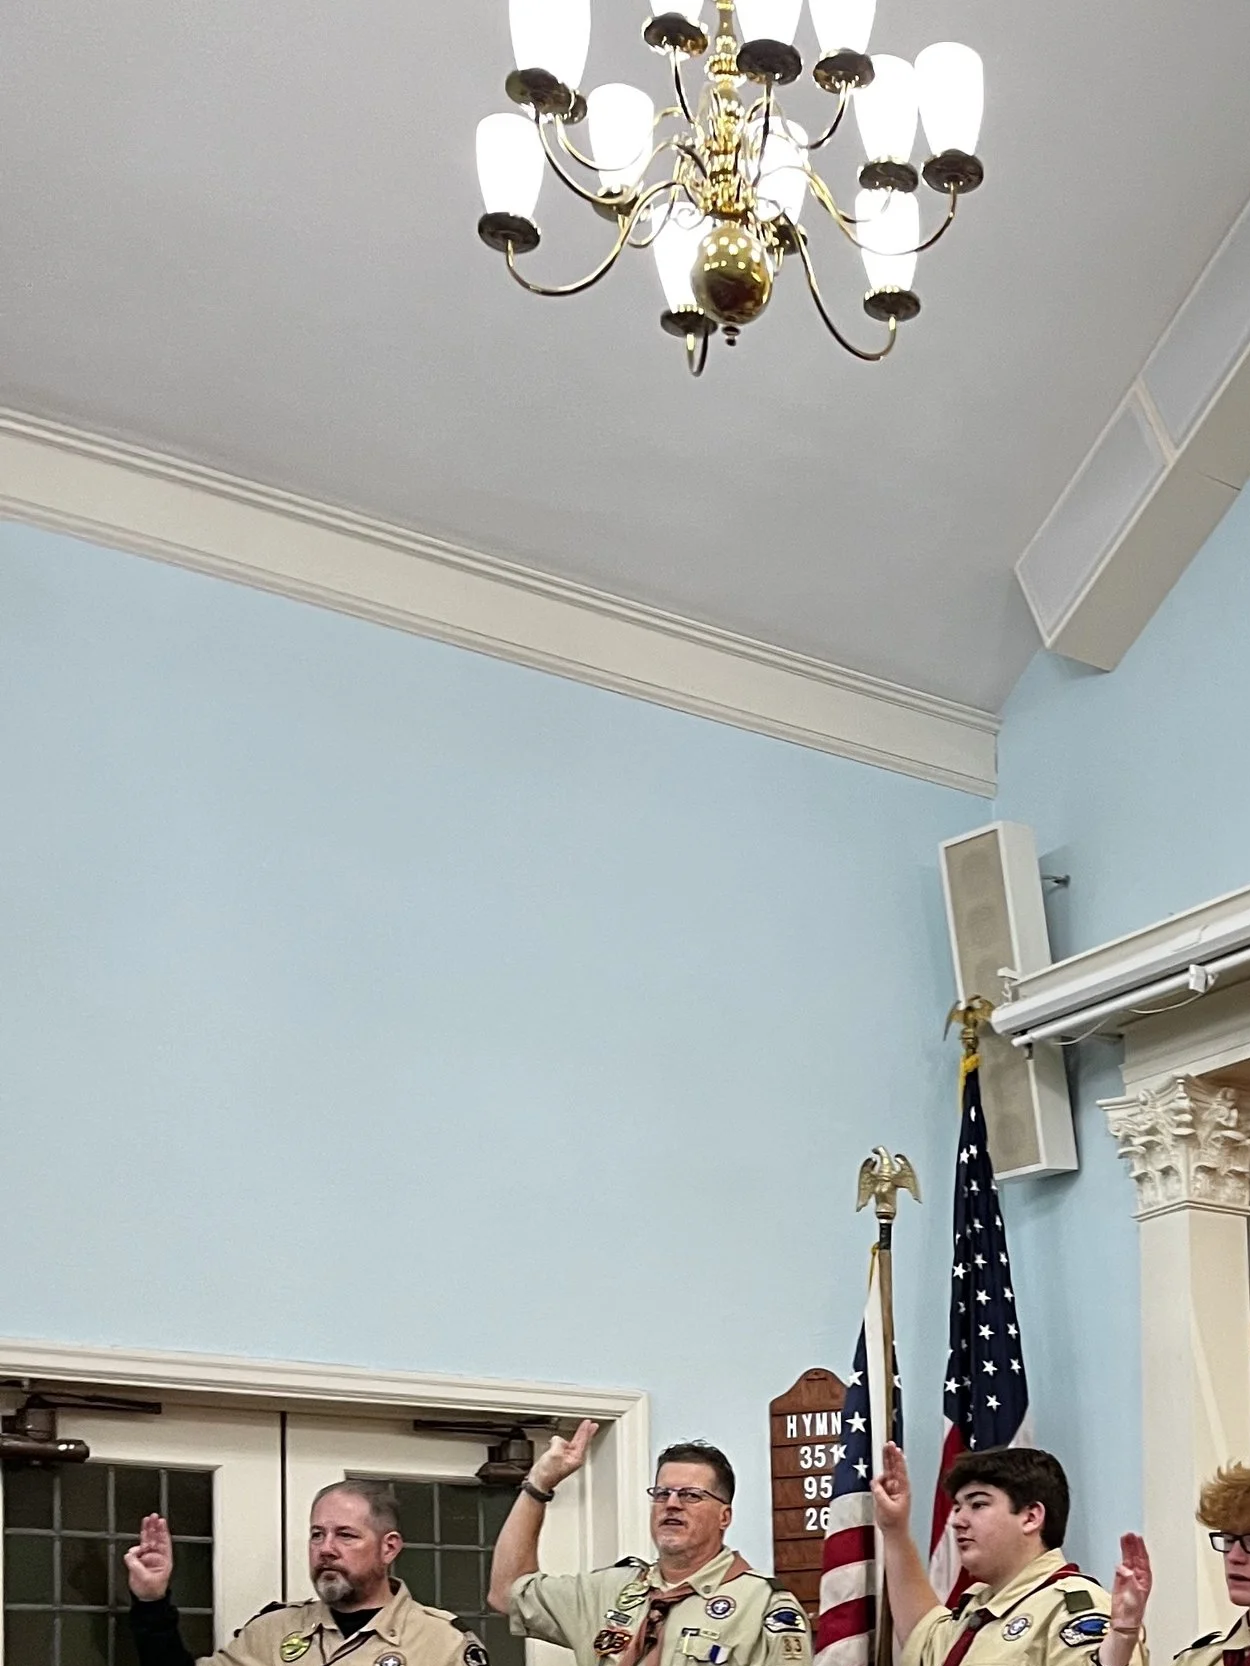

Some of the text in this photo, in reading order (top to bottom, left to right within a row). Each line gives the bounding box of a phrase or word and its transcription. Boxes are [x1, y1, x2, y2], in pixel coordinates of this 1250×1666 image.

[787, 1411, 842, 1438] HYMN
[804, 1475, 833, 1500] 95
[805, 1507, 831, 1531] 26
